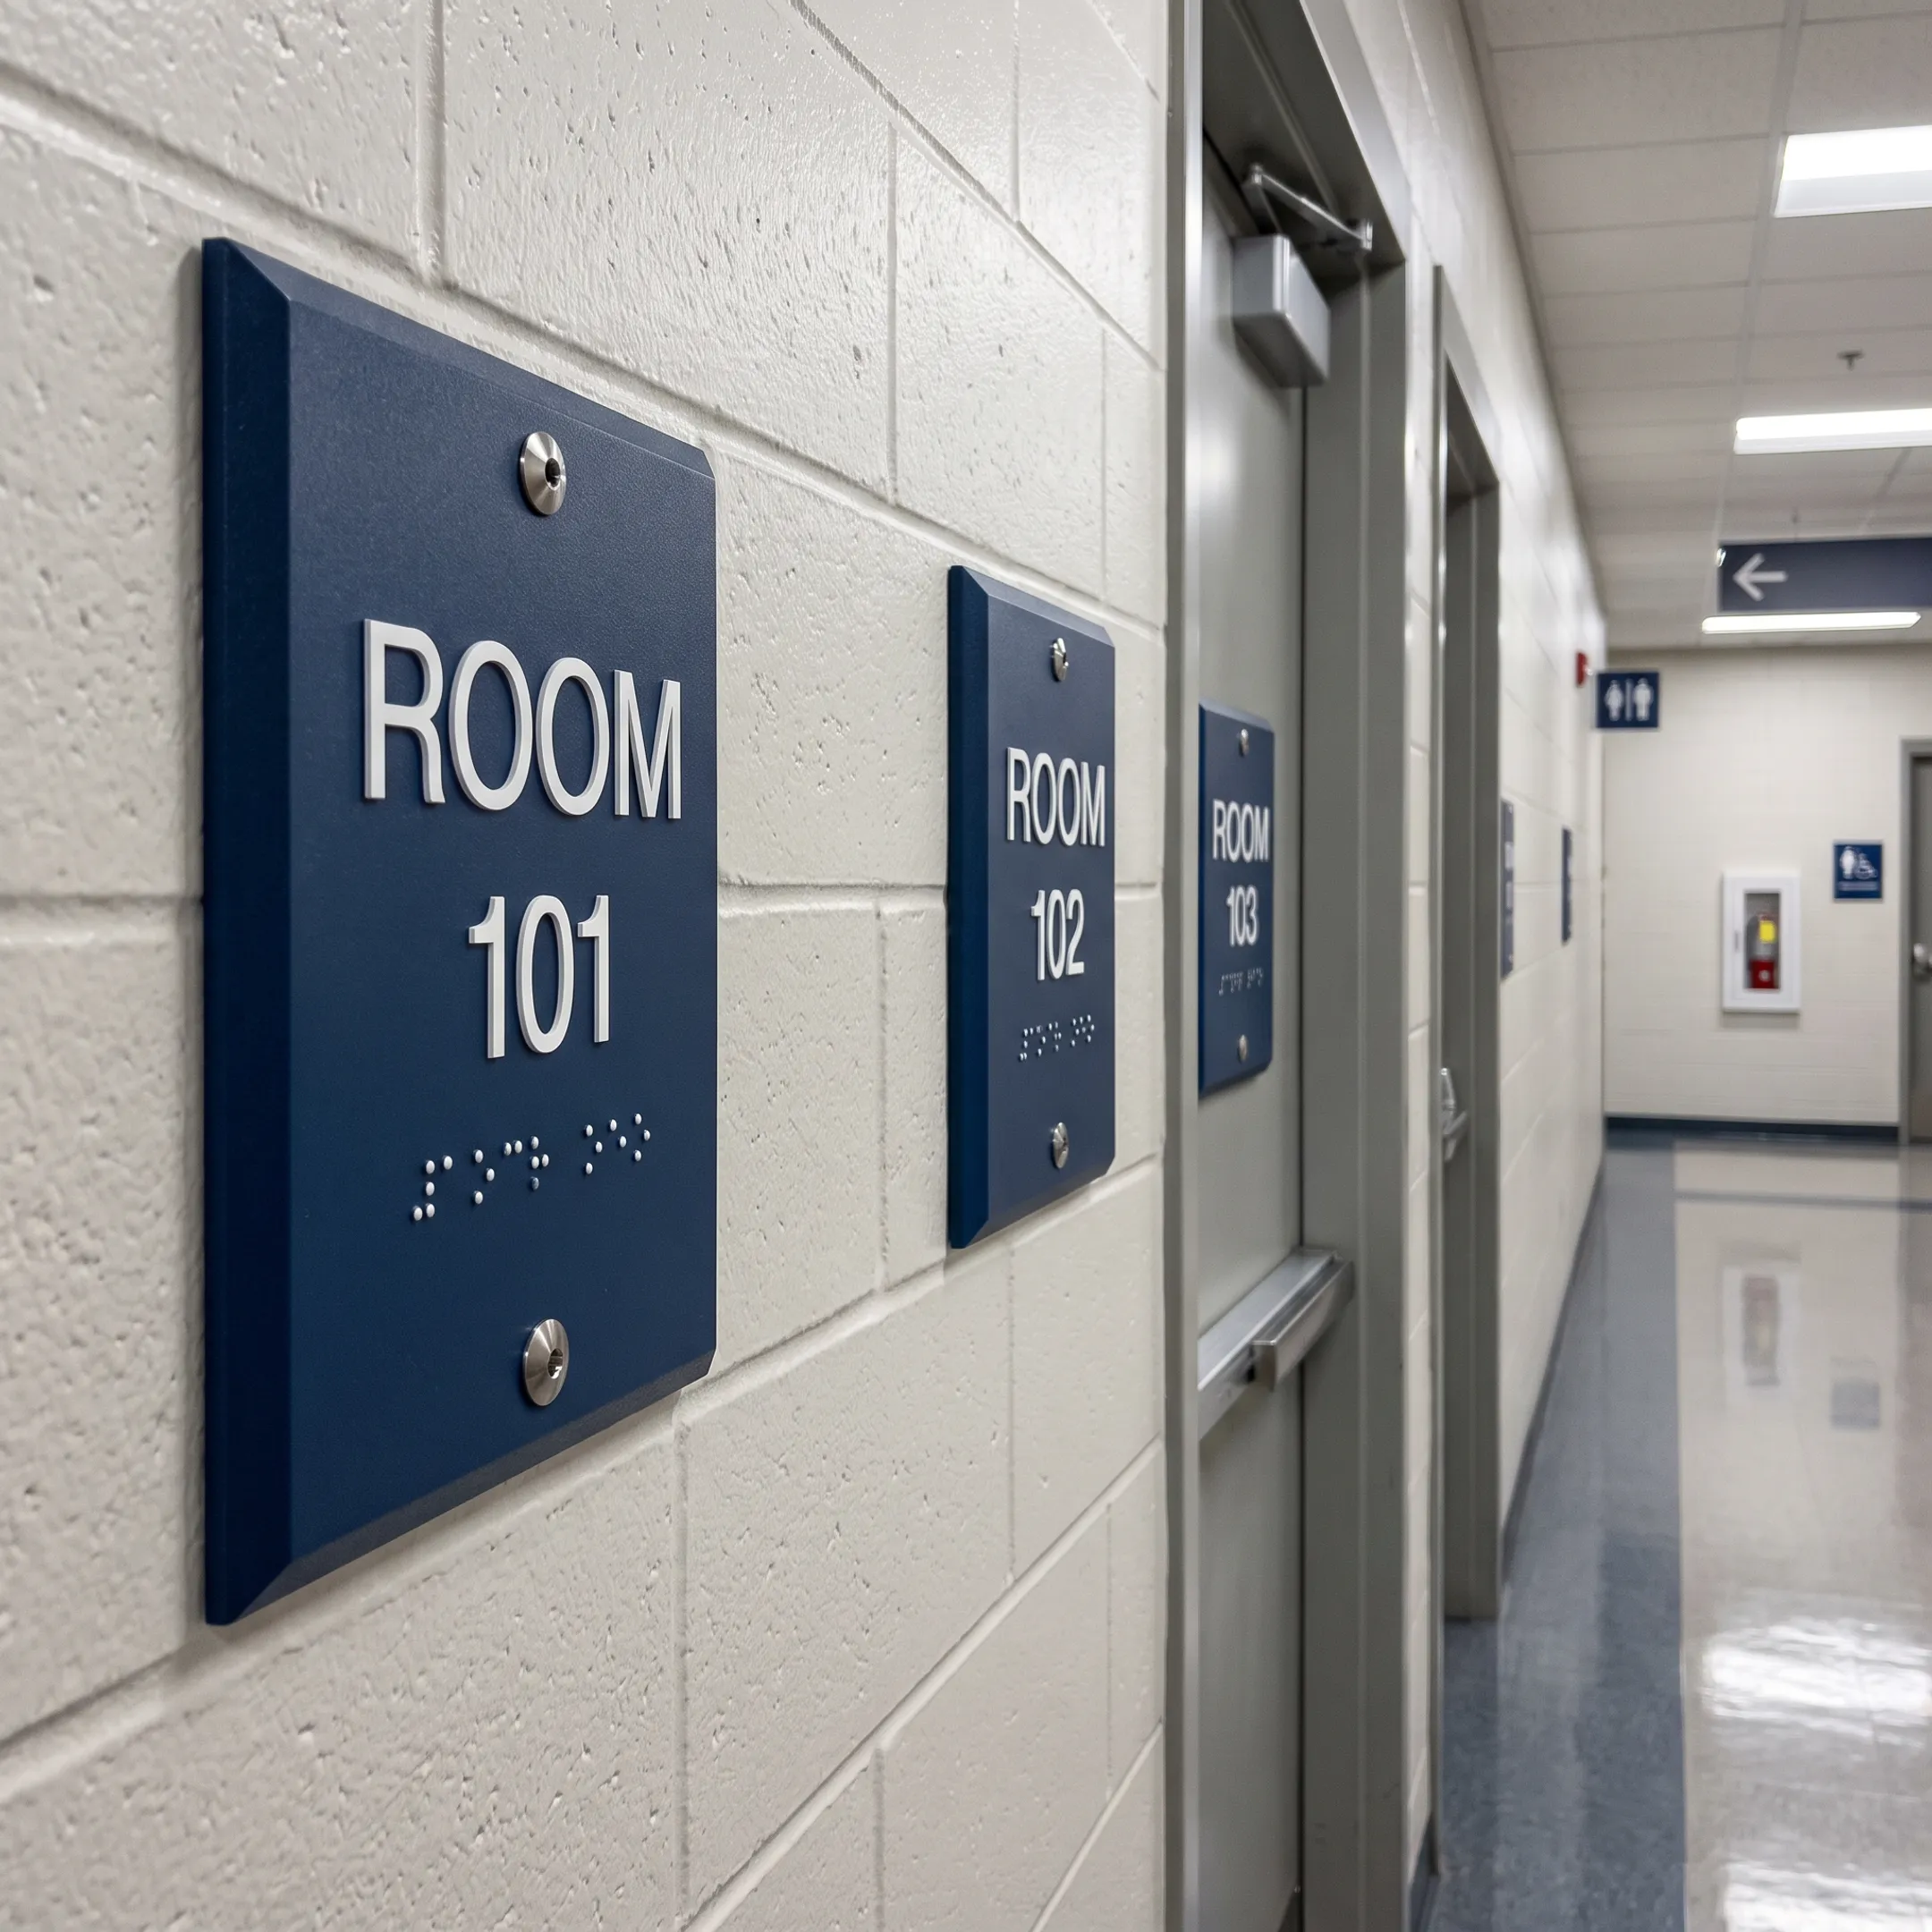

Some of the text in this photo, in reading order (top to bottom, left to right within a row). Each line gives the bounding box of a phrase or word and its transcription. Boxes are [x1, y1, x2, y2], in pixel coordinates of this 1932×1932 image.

[363, 618, 682, 821] ROOM
[1007, 746, 1106, 848] ROOM
[1212, 799, 1270, 862] ROOM
[1030, 888, 1085, 982] 102
[1226, 885, 1258, 947] 103
[468, 894, 611, 1059] 101
